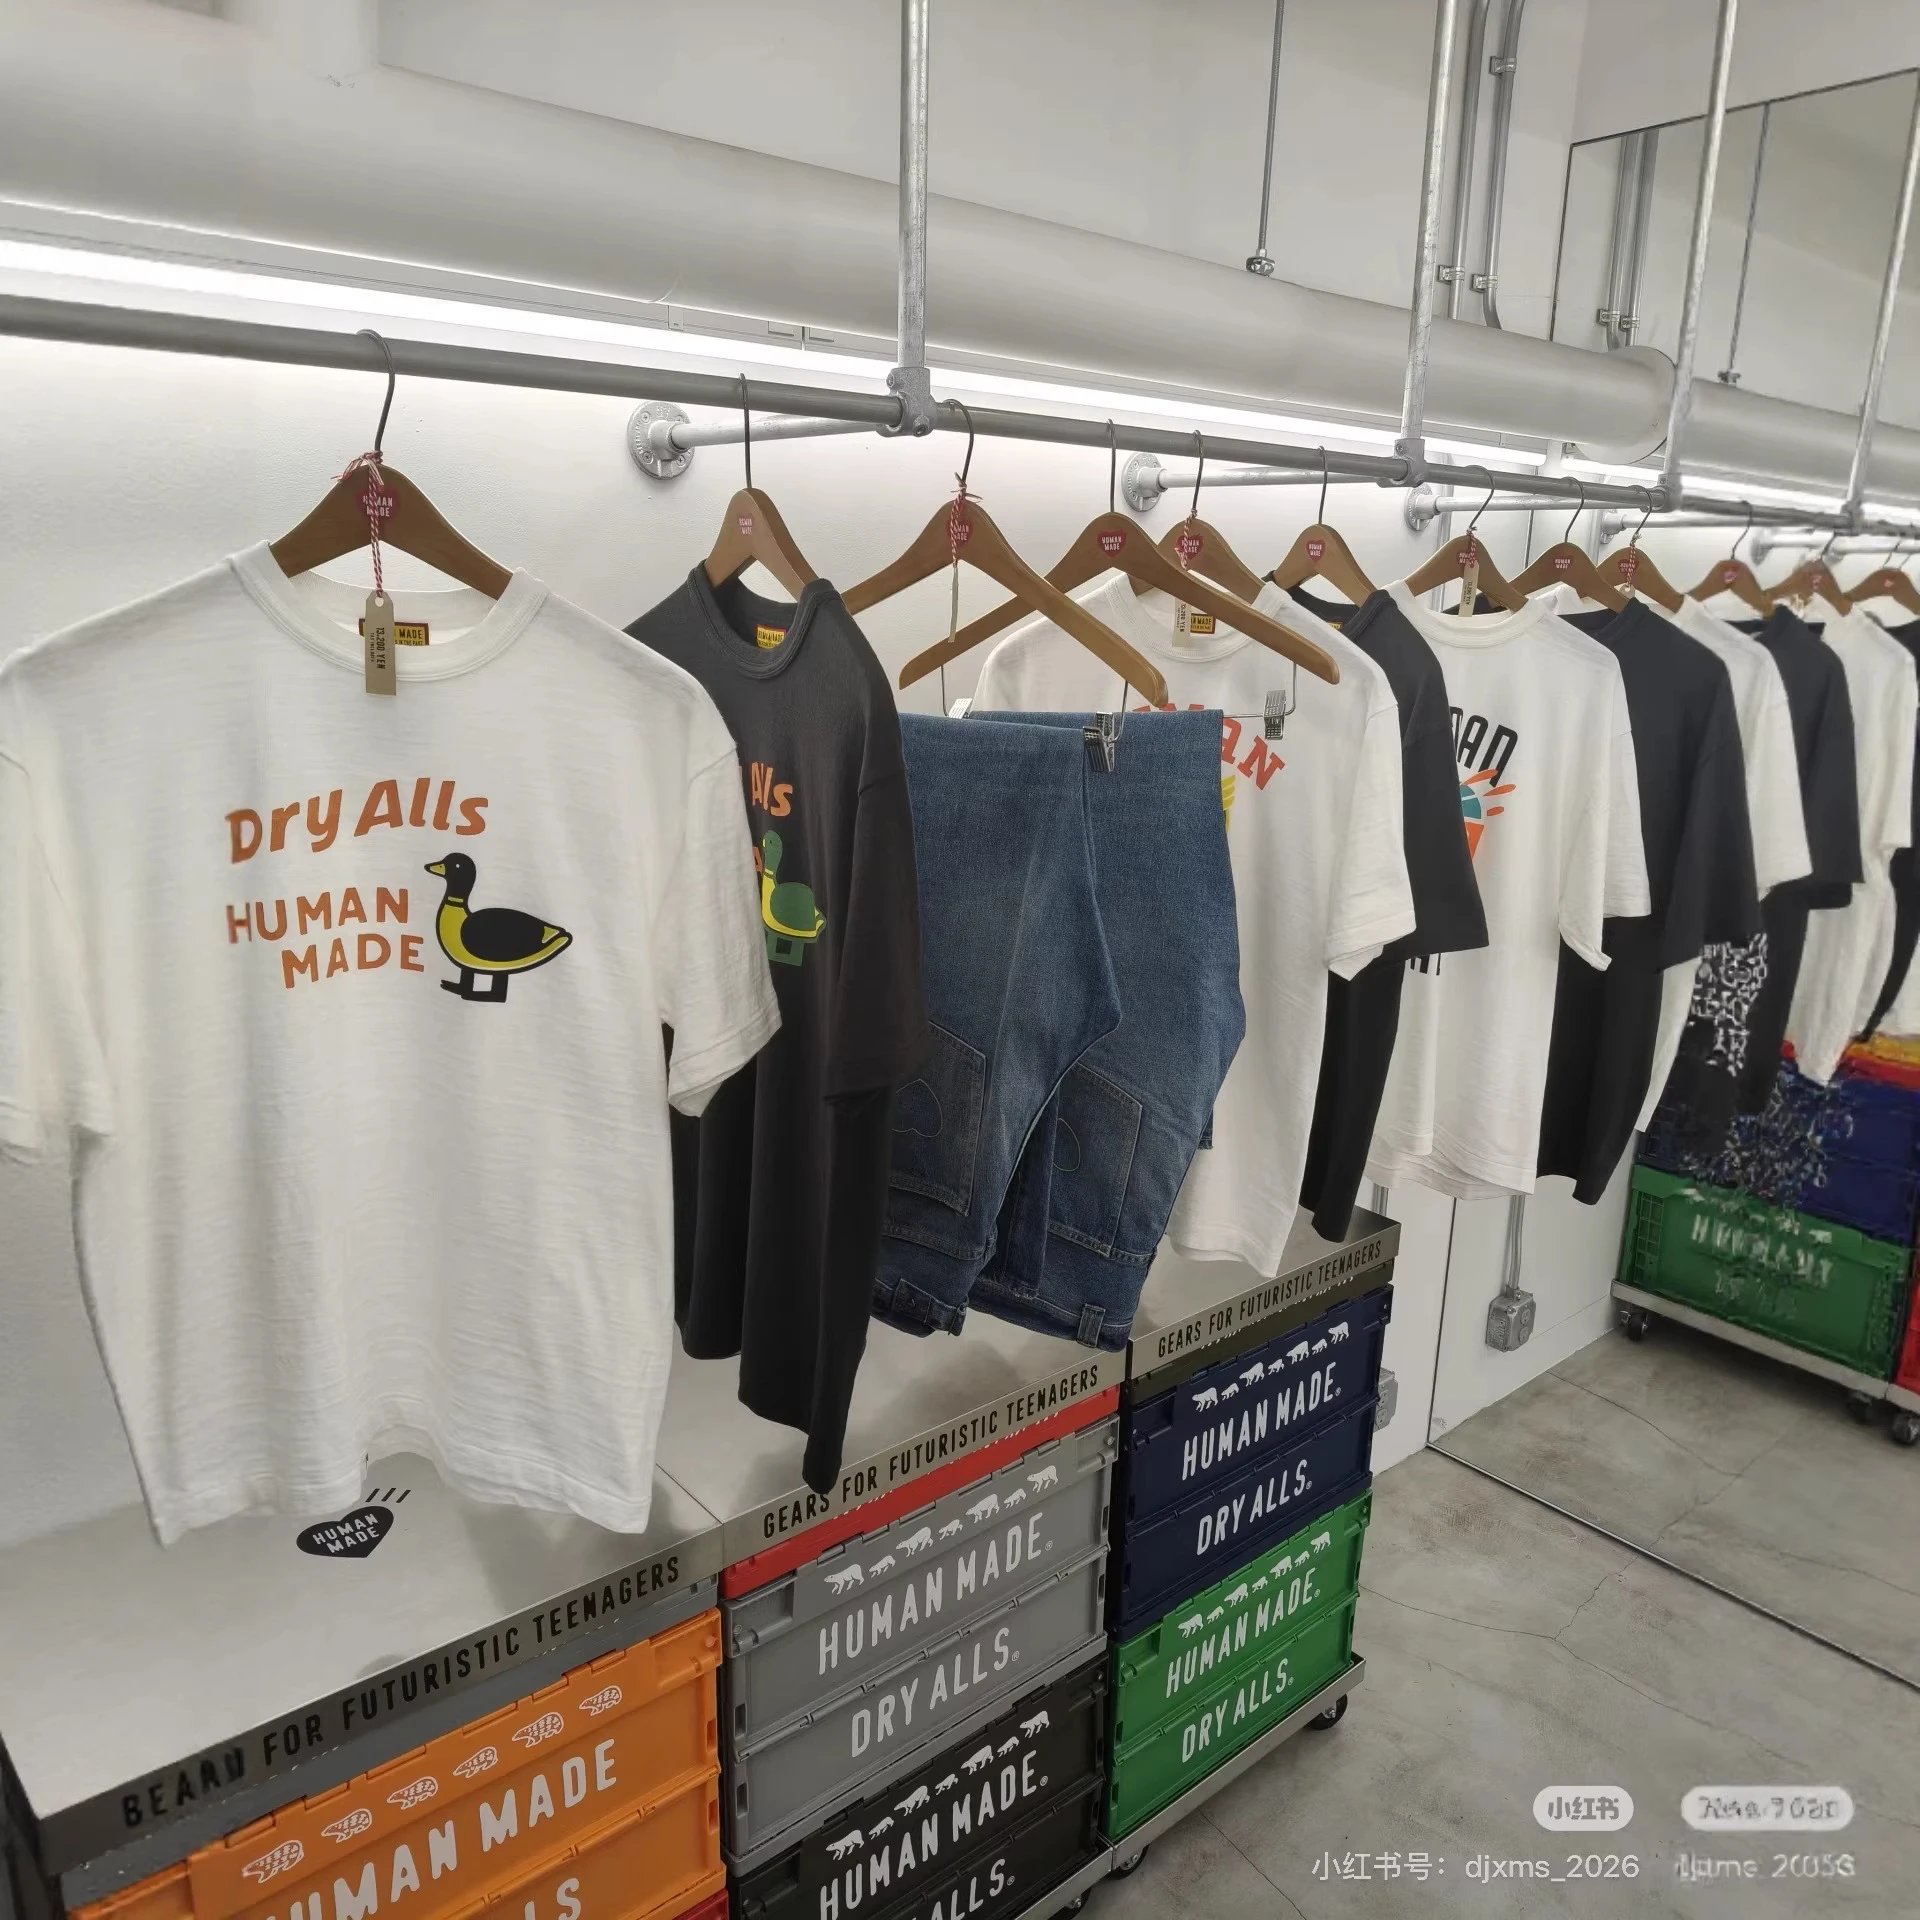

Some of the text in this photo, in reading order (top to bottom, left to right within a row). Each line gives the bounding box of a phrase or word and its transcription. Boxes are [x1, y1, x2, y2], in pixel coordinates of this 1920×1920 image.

[377, 654, 386, 669] YEN
[399, 629, 422, 639] MADE
[224, 777, 489, 864] Dry Alls
[226, 886, 409, 944] HUMAN
[281, 933, 425, 989] MADE
[1158, 1240, 1381, 1358] GEARS FOR FUTURISTIC TEENAGERS
[763, 1365, 1099, 1539] GEARS FOR FUTURISTIC TEENAGERS
[1182, 1399, 1268, 1481] HUMAN
[313, 1513, 378, 1544] HUMAN
[326, 1526, 379, 1553] MADE
[1197, 1493, 1246, 1556] DRY
[263, 1713, 324, 1767] FOR
[342, 1626, 520, 1731] FUTURISTIC
[532, 1555, 680, 1644] TEENAGERS
[818, 1567, 943, 1676] HUMAN
[1166, 1612, 1248, 1699] HUMAN
[851, 1677, 919, 1758] DRY
[1182, 1699, 1228, 1763] DRY
[266, 1819, 457, 1920] MAN
[479, 1738, 617, 1852] MADE
[820, 1813, 939, 1920] HUMAN
